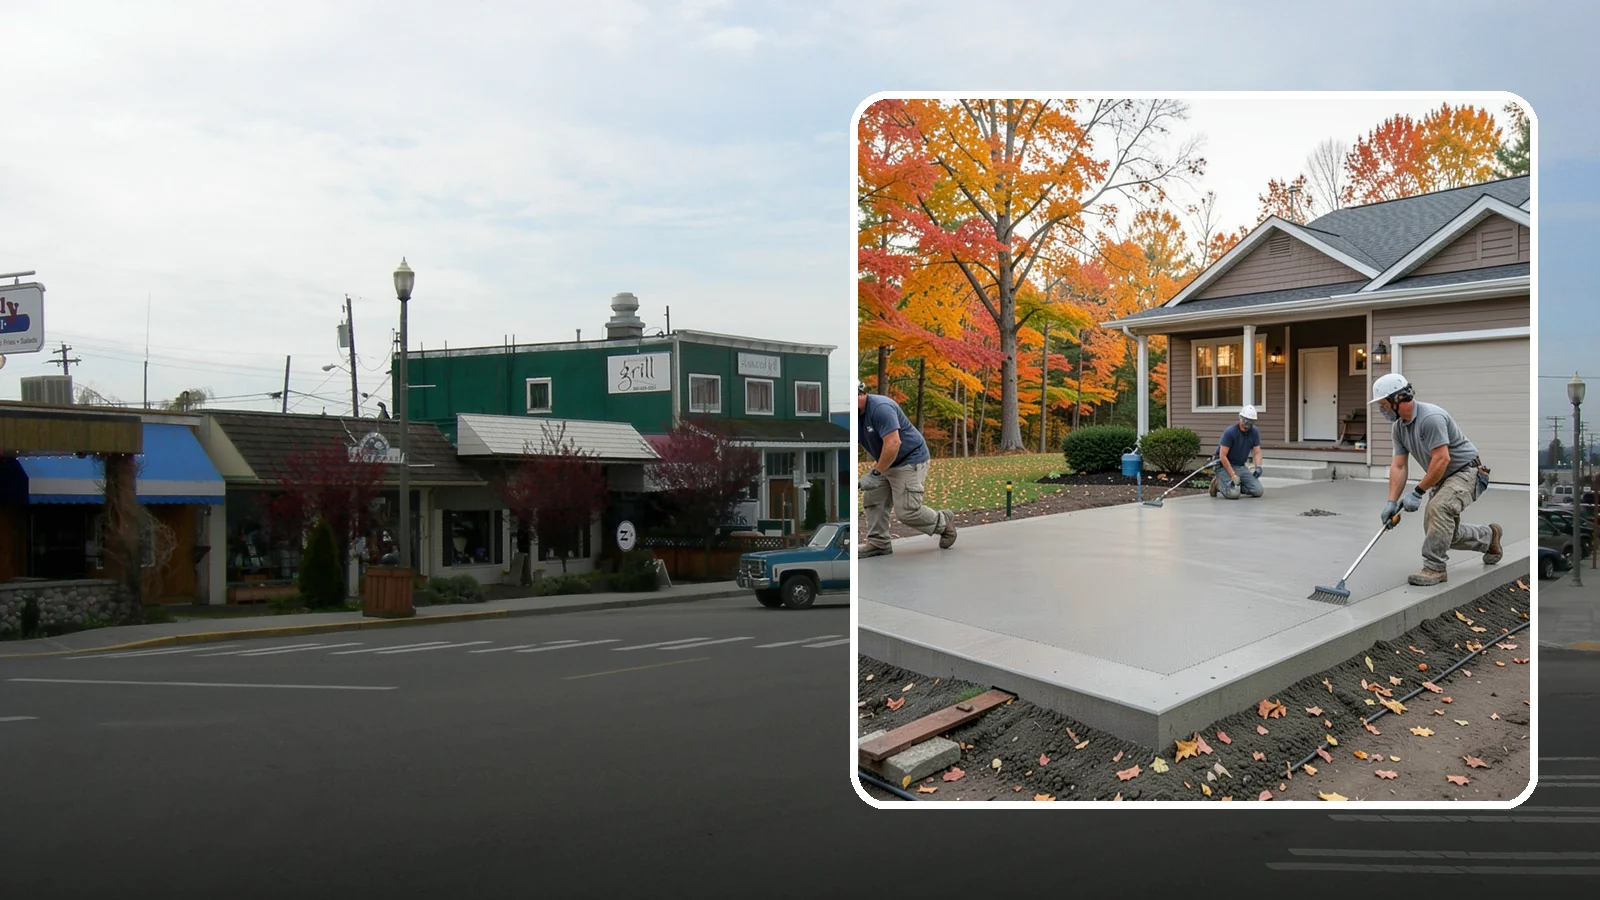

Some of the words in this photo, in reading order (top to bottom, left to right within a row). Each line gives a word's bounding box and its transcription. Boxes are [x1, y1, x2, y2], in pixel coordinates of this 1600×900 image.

[3, 338, 16, 346] Fries
[20, 336, 38, 345] Salads
[617, 355, 655, 392] grill
